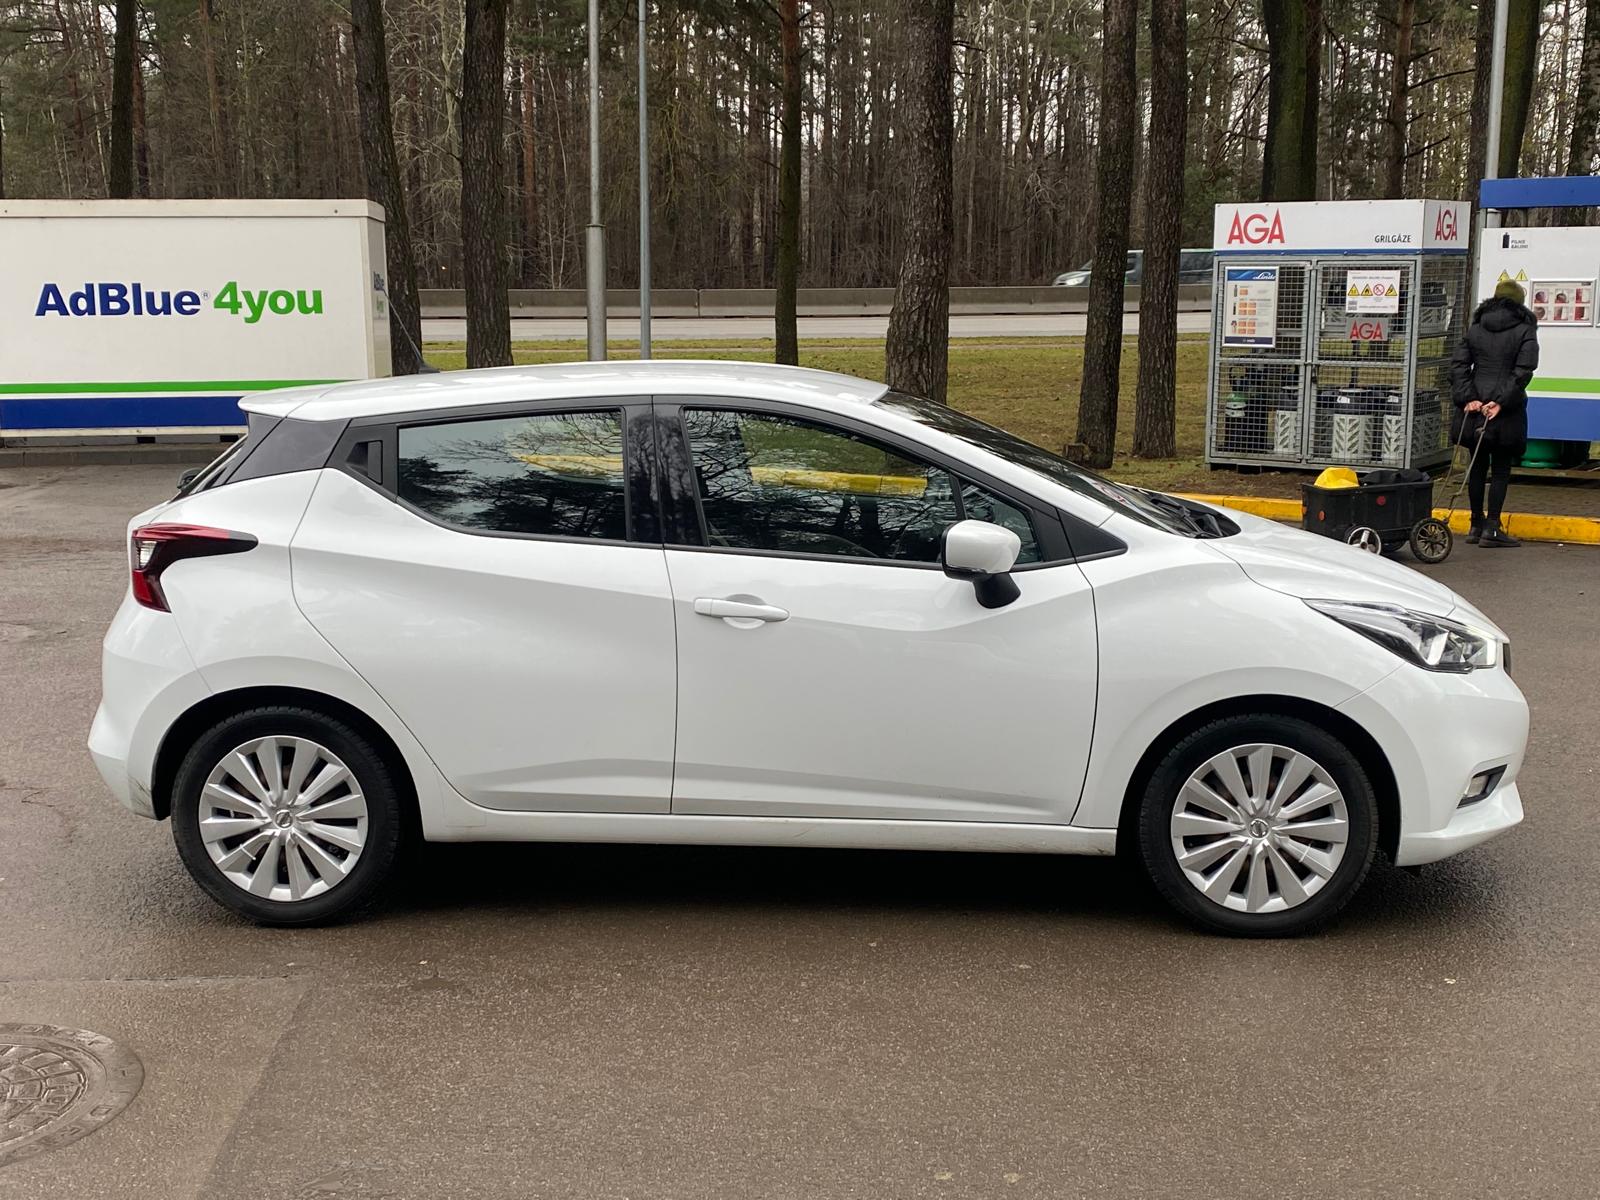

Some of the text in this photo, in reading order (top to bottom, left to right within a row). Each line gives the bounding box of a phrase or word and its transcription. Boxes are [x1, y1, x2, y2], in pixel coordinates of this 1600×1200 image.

[1227, 207, 1285, 244] AGA
[1435, 204, 1458, 241] AGA
[213, 281, 323, 324] 4you
[1350, 319, 1383, 340] AGA
